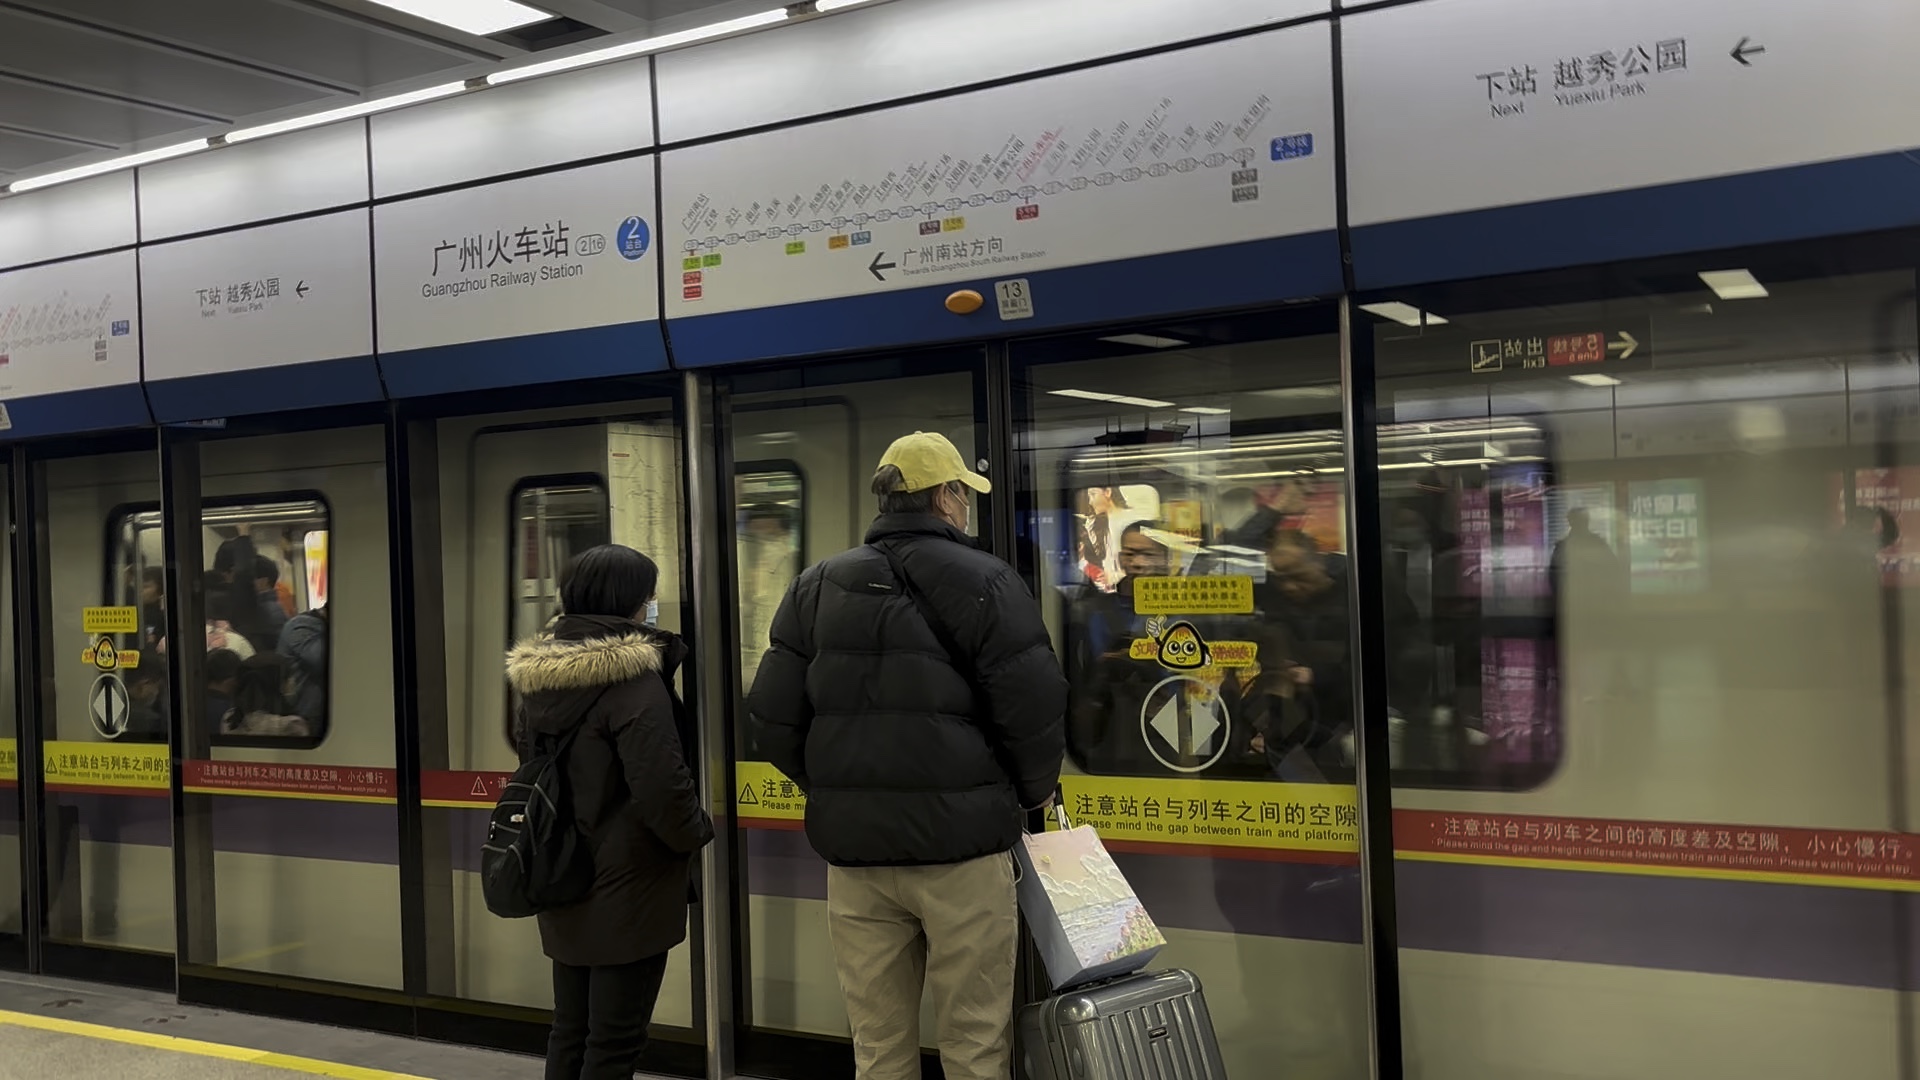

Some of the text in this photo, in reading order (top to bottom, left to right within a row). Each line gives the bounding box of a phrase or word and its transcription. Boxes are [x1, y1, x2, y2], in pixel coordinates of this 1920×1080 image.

[1475, 38, 1688, 100] 下站 越秀公园
[1489, 80, 1646, 119] Next Yuexiu Park
[627, 216, 641, 239] 2
[432, 220, 569, 276] 广州火车站
[580, 240, 588, 252] 2
[625, 240, 643, 250] 站台
[902, 236, 1003, 267] 广州南站方向
[195, 277, 280, 306] 下站 越秀公园
[422, 264, 583, 298] Guangzhou Railway Station
[1002, 281, 1023, 299] 13
[762, 778, 808, 798] 注意
[762, 800, 790, 810] Please
[1075, 793, 1358, 828] 注意站台与列车之间的空隙
[1075, 817, 1112, 829] Please
[1116, 819, 1142, 831] mind
[1146, 821, 1163, 832] the
[1168, 824, 1189, 836] gap
[1194, 823, 1241, 837] between
[1246, 826, 1273, 838] train
[1277, 828, 1300, 839] and
[1437, 838, 1468, 849] Please
[1470, 840, 1493, 850] mind
[1495, 842, 1510, 851] the
[1512, 844, 1530, 855] gap
[1531, 844, 1549, 853] and
[1551, 845, 1582, 857] height
[1583, 846, 1633, 858] difference
[1635, 849, 1678, 861] between
[1681, 853, 1705, 863] train
[1707, 853, 1727, 863] and
[1779, 857, 1817, 869] Please
[1820, 860, 1854, 871] watch
[1856, 862, 1882, 873] your
